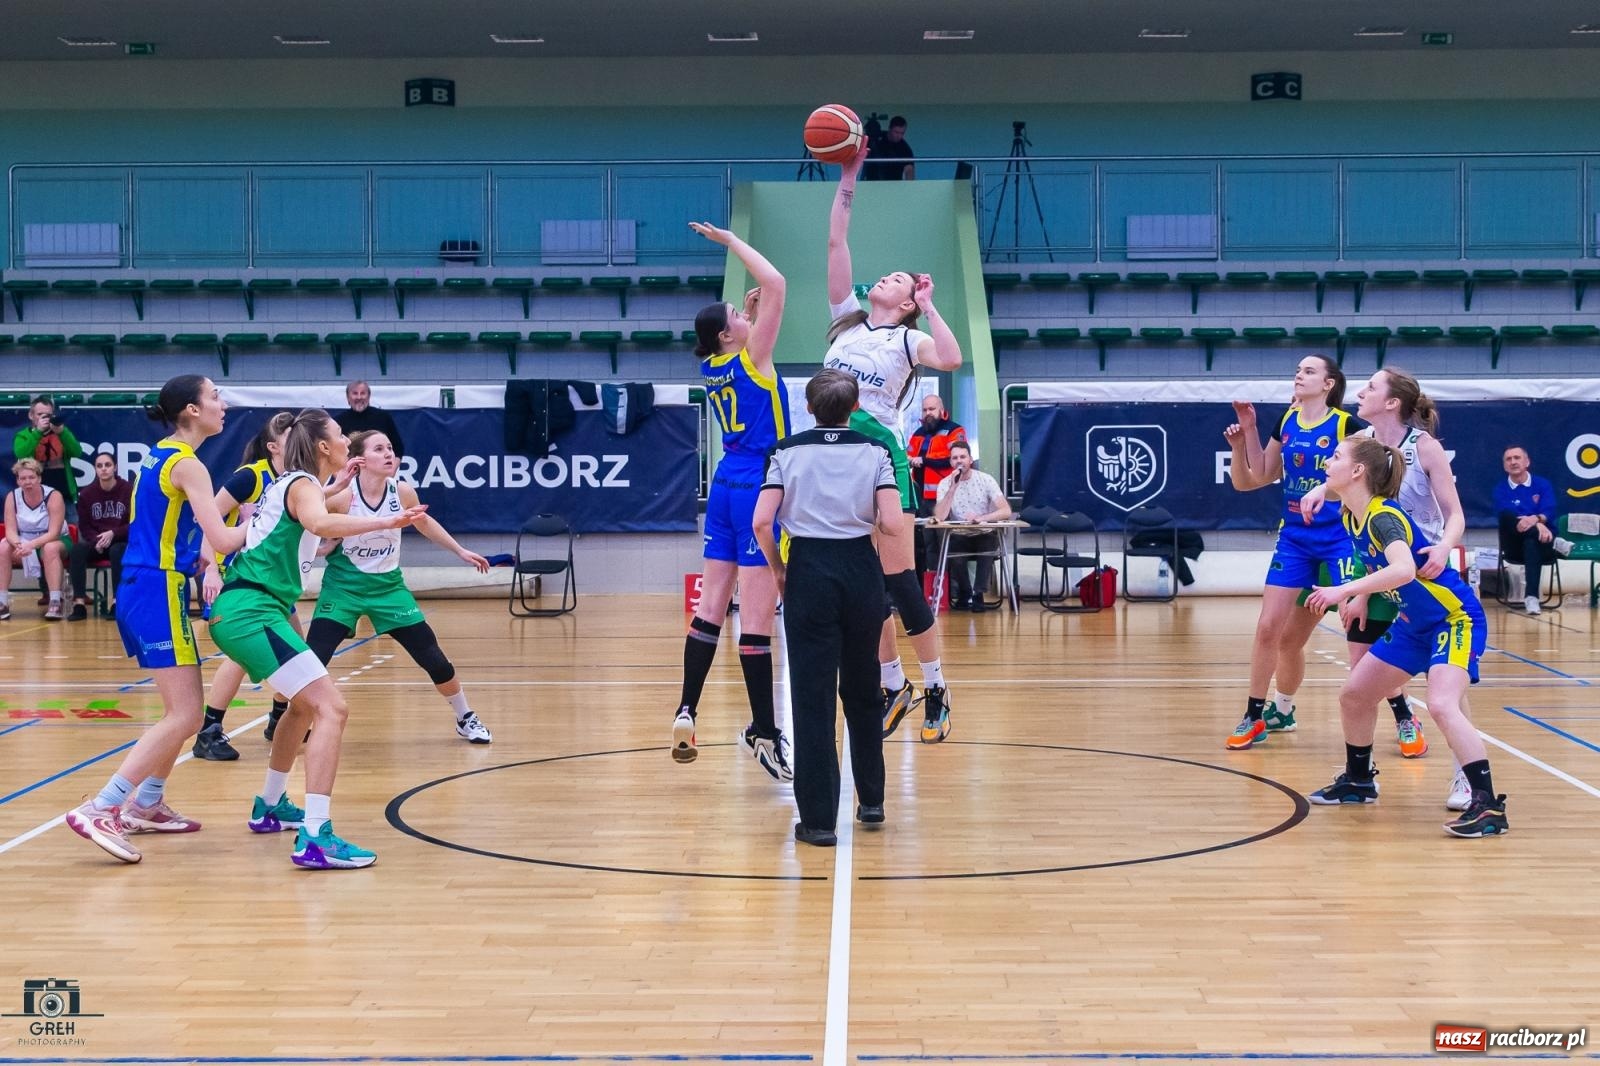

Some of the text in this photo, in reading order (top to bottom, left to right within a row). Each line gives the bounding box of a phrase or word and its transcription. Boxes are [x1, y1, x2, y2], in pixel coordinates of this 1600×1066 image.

[409, 87, 421, 103] B
[432, 87, 449, 102] B
[1256, 81, 1275, 97] C
[1284, 81, 1298, 97] C
[709, 386, 746, 433] 12
[395, 443, 631, 489] RACIBÓRZ
[91, 501, 126, 520] GAP
[357, 544, 395, 558] Clavi
[1338, 557, 1355, 579] 14
[1436, 631, 1449, 653] 9
